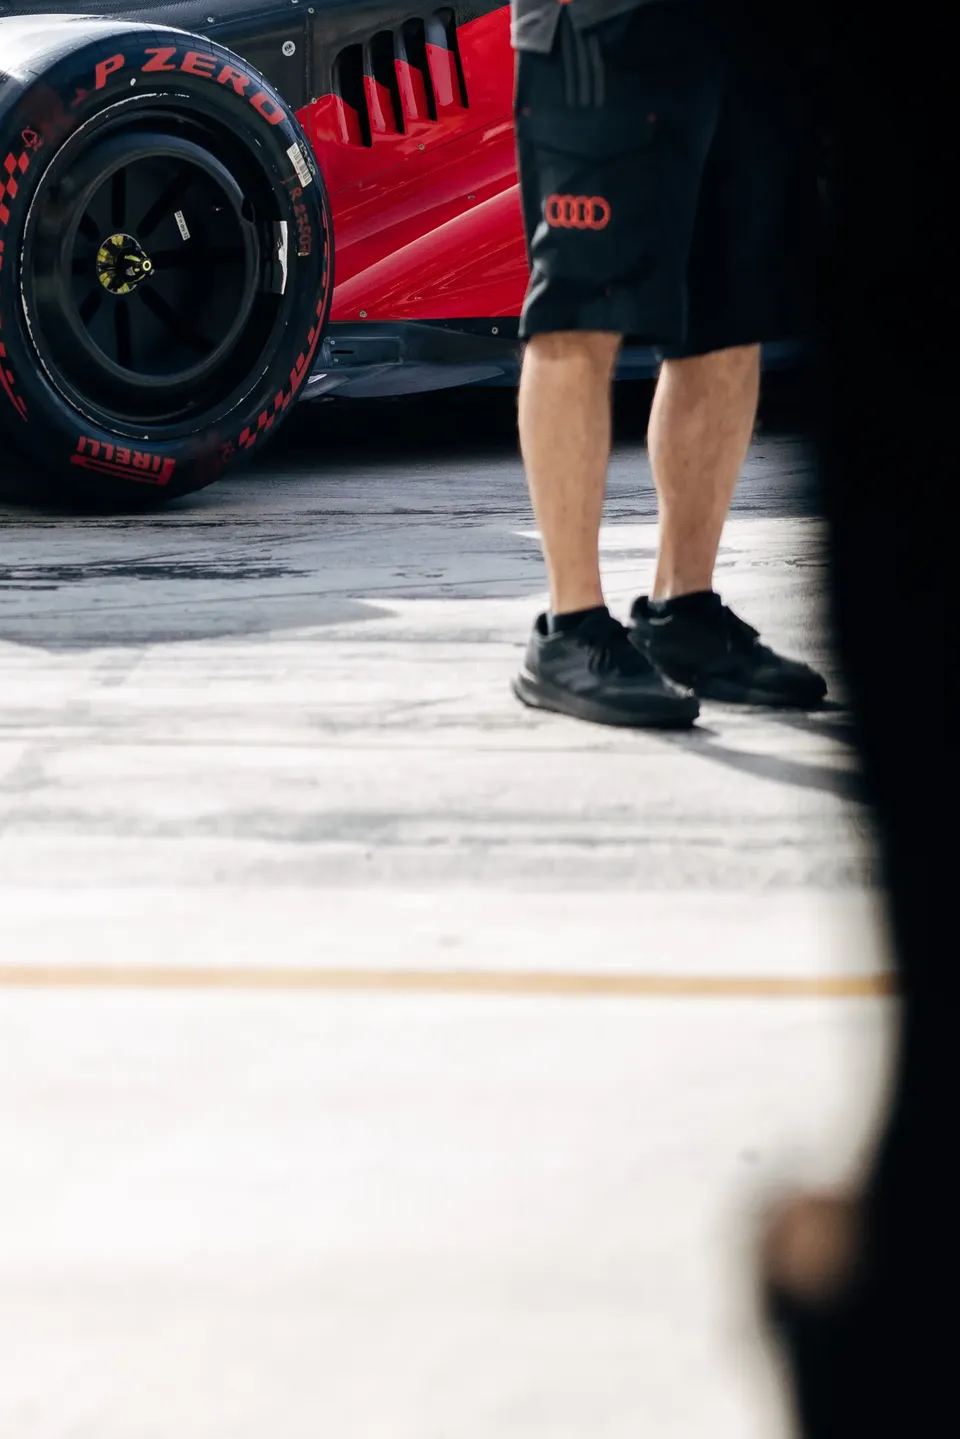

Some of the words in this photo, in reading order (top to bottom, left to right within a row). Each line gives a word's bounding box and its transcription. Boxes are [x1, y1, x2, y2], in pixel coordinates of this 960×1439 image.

[95, 53, 125, 90] P
[142, 47, 286, 125] ZERO
[71, 436, 176, 486] PIRELLI
